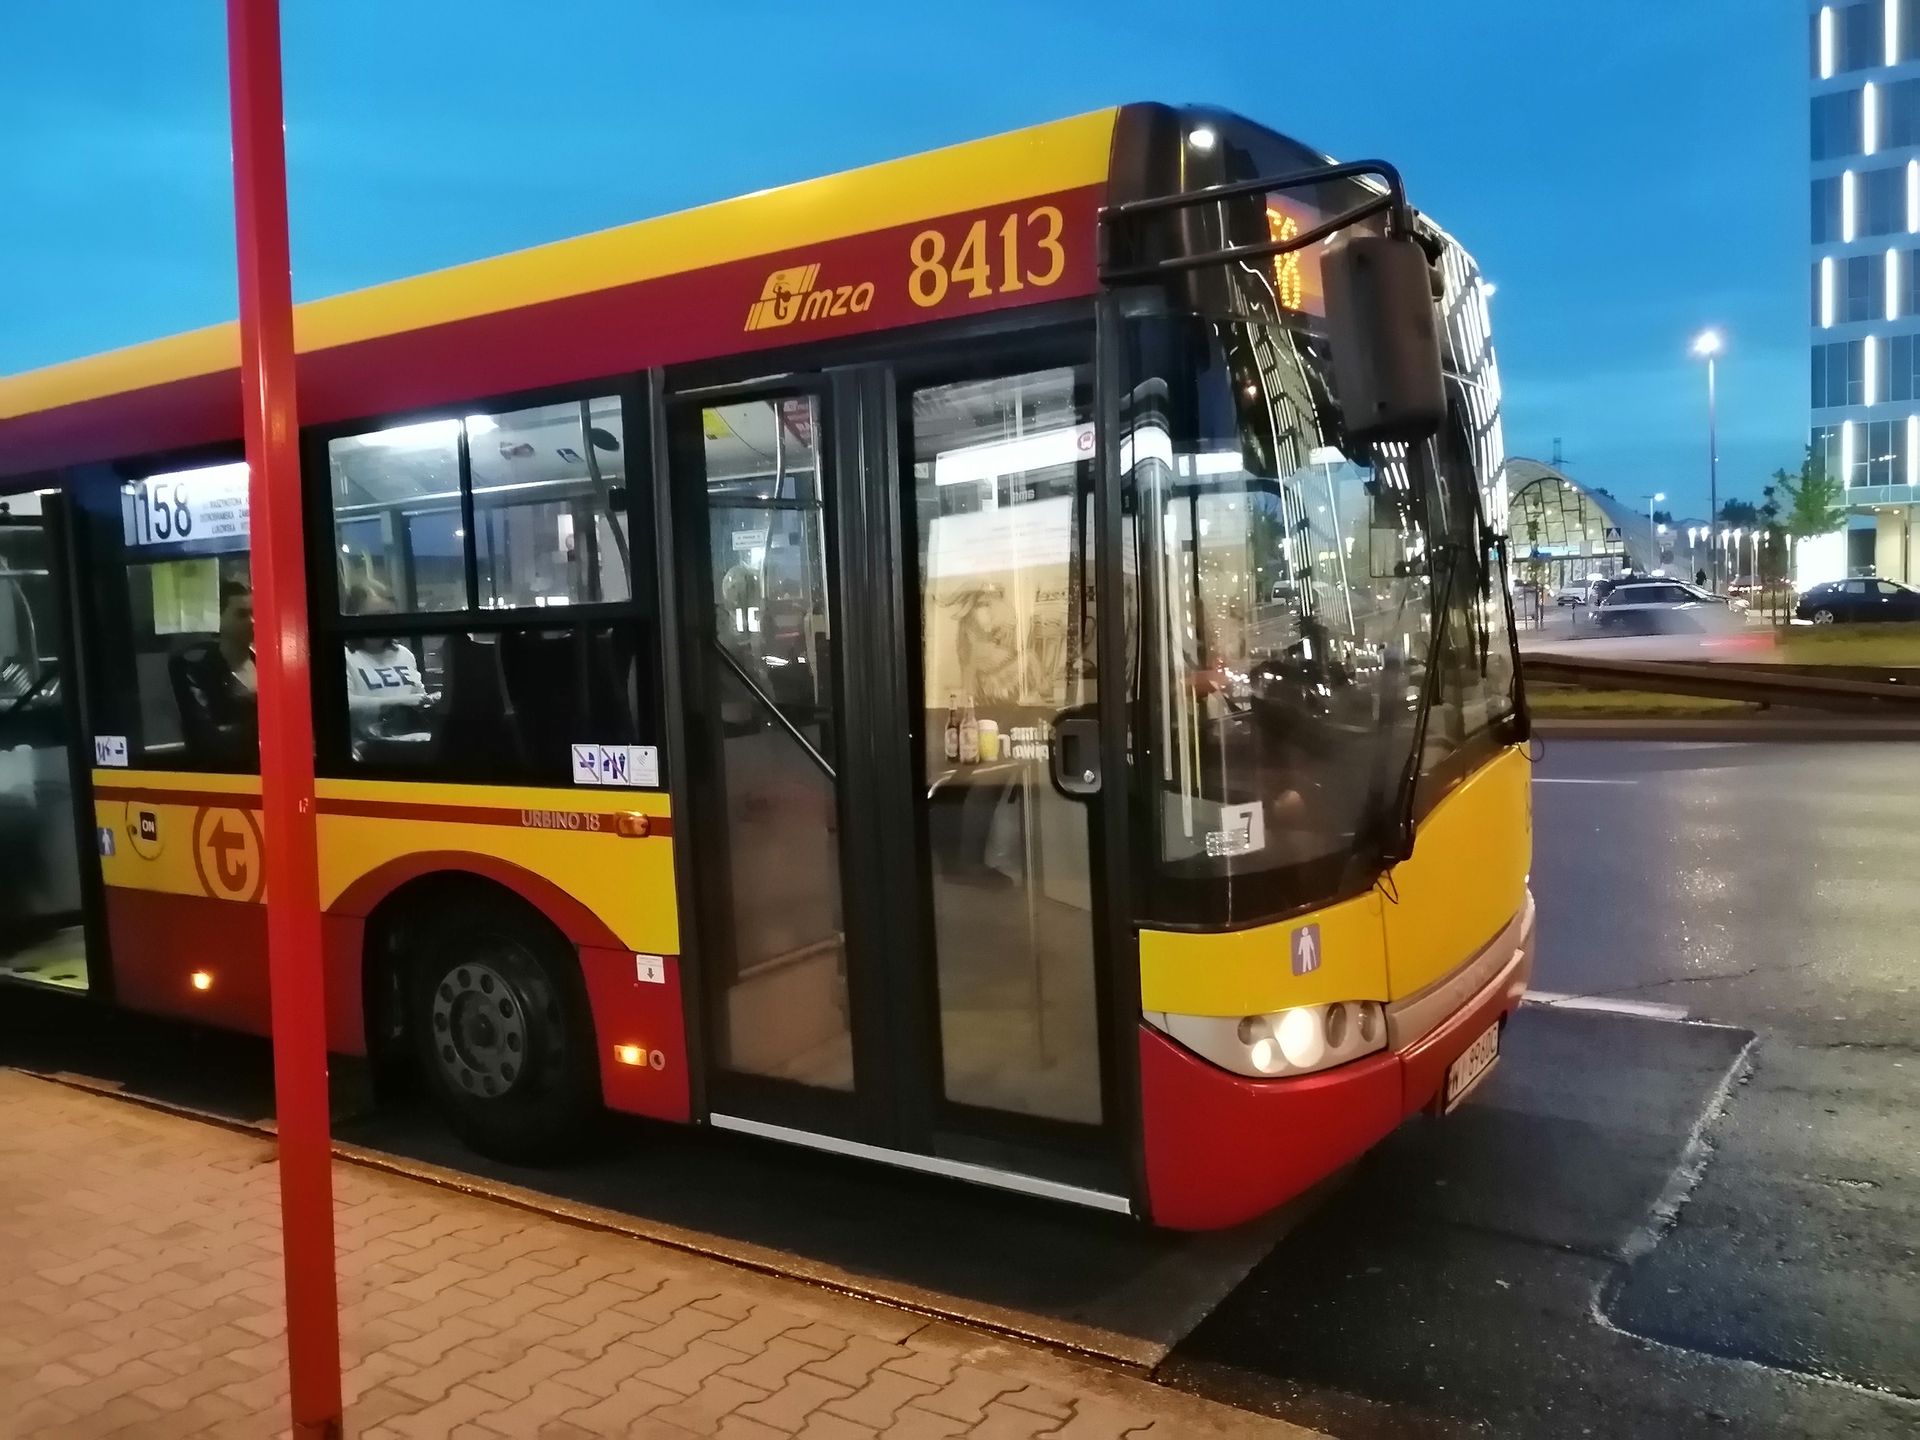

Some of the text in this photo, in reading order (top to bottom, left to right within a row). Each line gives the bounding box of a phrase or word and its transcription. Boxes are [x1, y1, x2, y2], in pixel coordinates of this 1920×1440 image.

[908, 206, 1065, 308] 8413
[800, 281, 875, 322] mza
[139, 482, 192, 542] 158
[358, 665, 416, 690] LEE
[142, 818, 155, 834] ON
[521, 809, 600, 831] URBINO 18
[1239, 811, 1253, 844] 7
